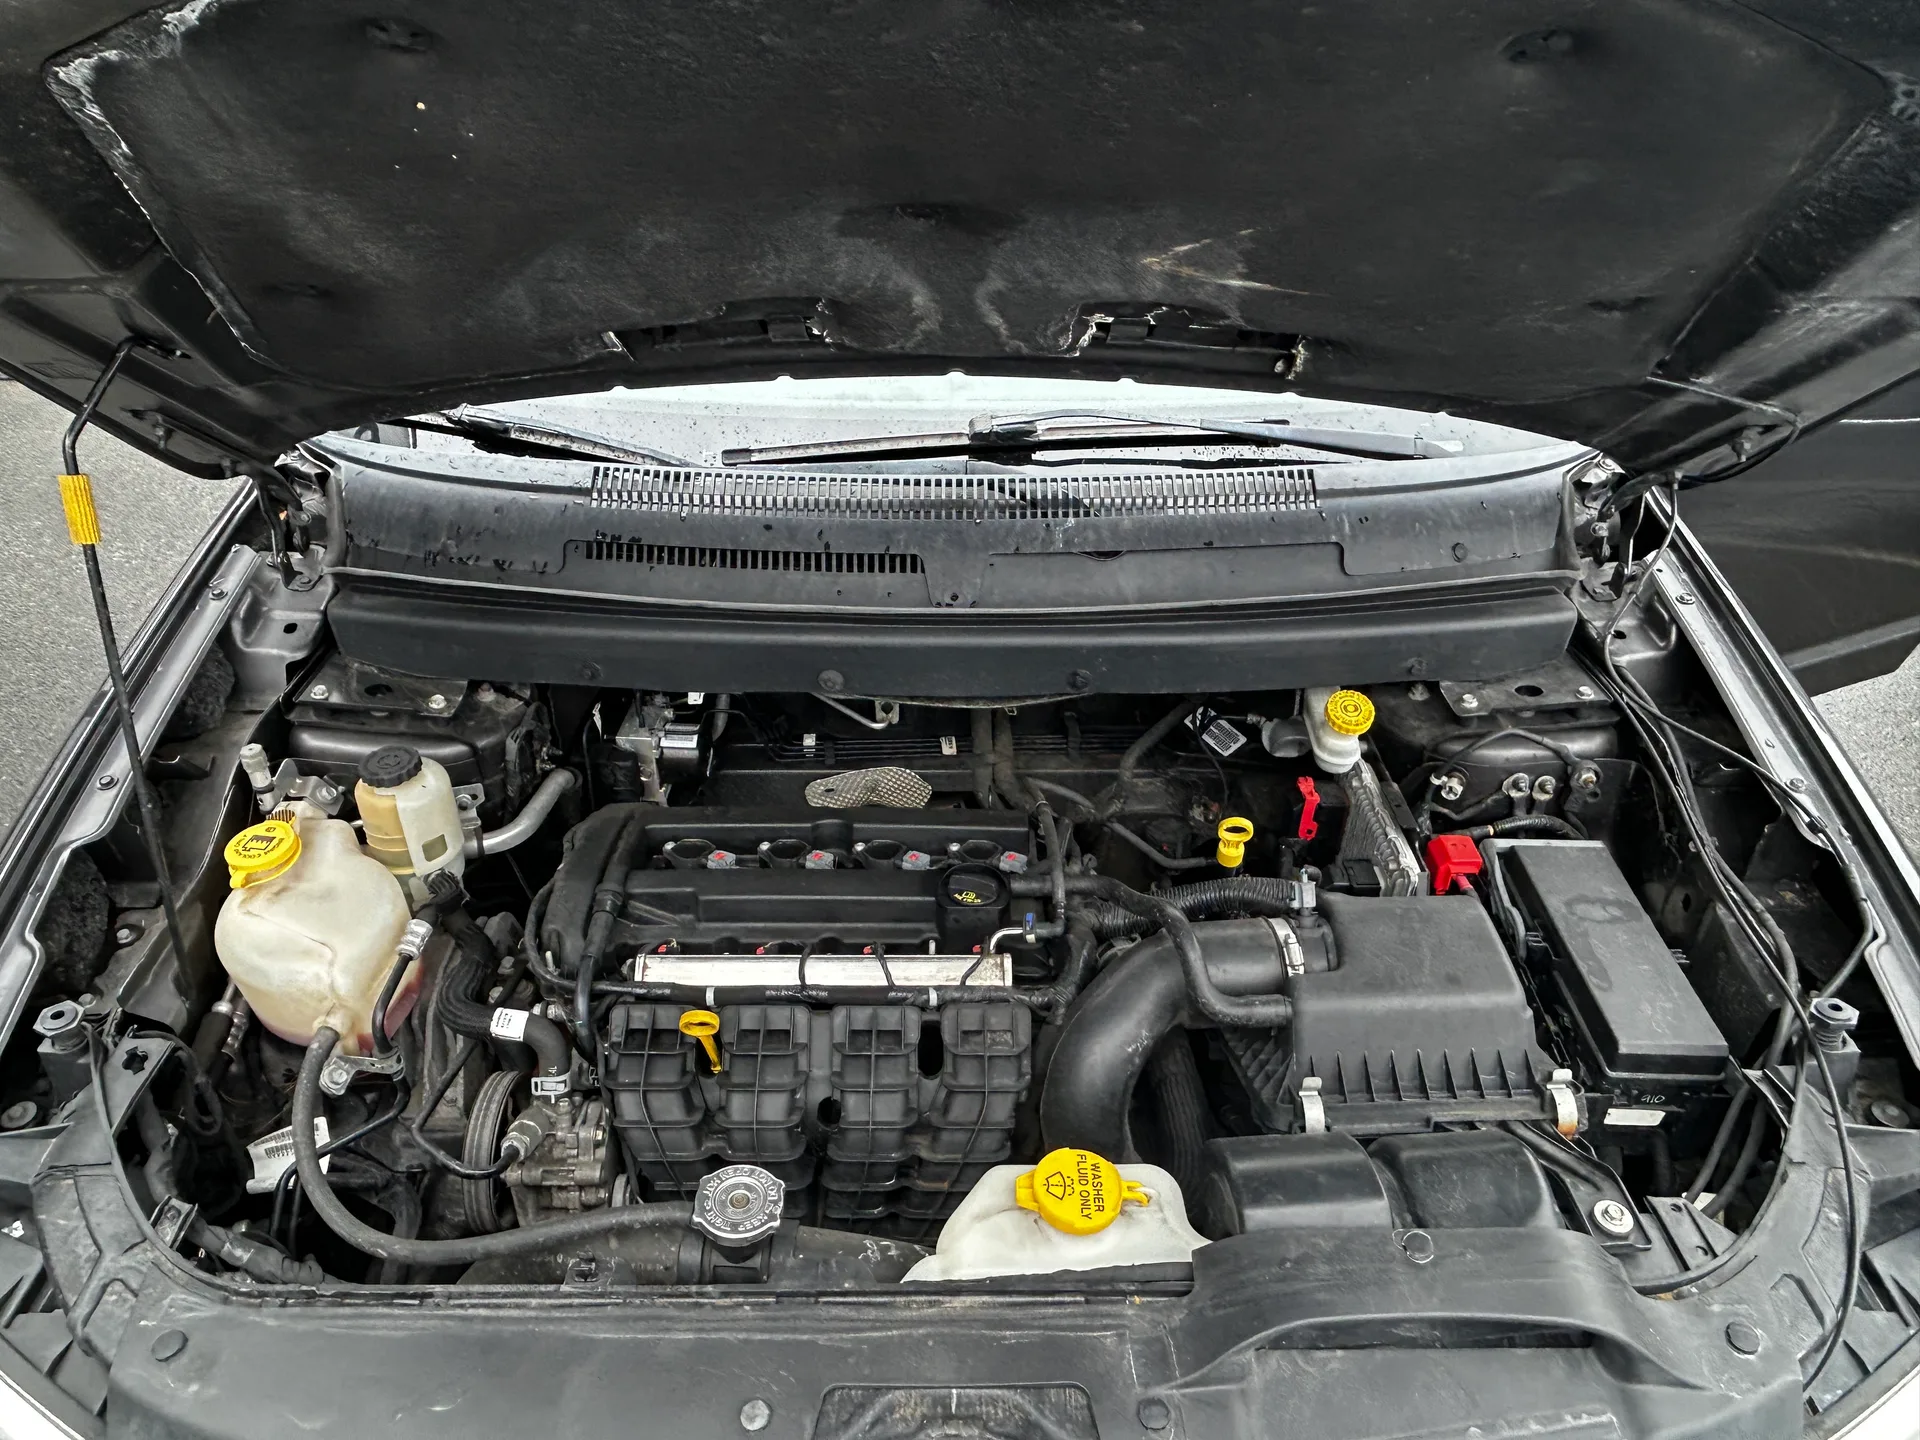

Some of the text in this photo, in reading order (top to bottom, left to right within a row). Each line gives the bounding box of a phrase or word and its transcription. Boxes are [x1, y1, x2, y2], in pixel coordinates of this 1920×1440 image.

[719, 1168, 750, 1180] OPEN
[751, 1169, 774, 1187] NOT
[703, 1177, 721, 1197] HOT
[1076, 1153, 1093, 1220] FLUID ONLY
[1090, 1162, 1105, 1213] WASHER
[704, 1211, 768, 1231] KEEP TIGHT
